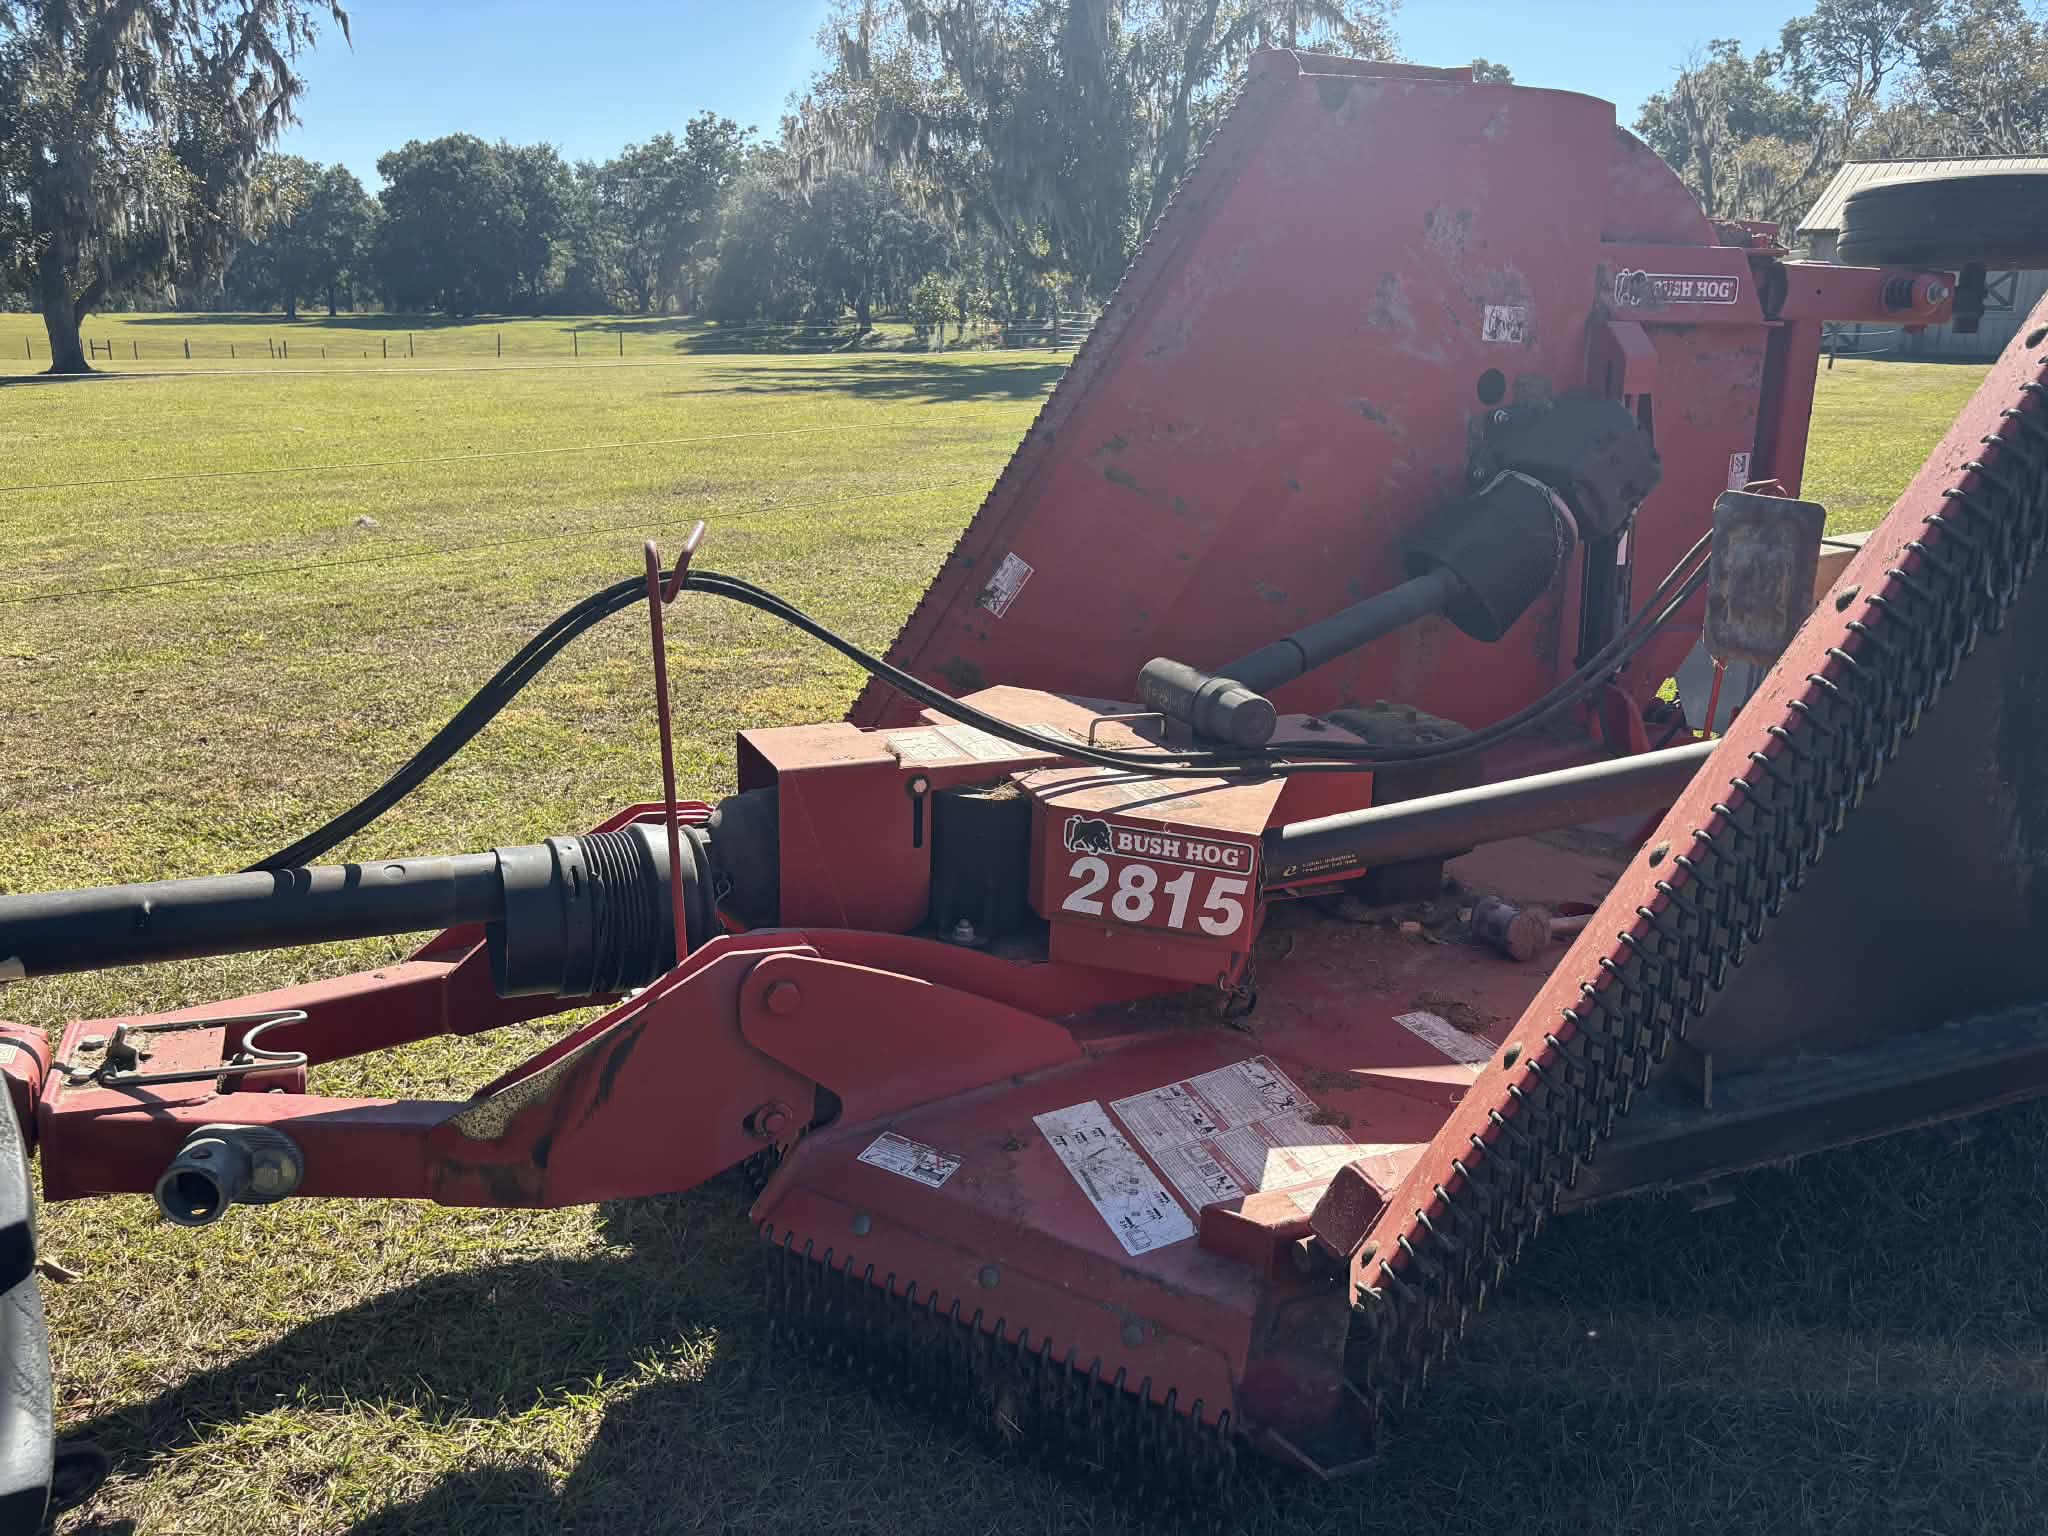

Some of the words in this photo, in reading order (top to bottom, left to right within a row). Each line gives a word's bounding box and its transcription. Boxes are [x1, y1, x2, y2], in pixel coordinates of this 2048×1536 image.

[1696, 281, 1729, 297] HOG
[1117, 831, 1181, 859] BUSH
[1185, 842, 1240, 867] HOG
[1061, 856, 1248, 937] 2815
